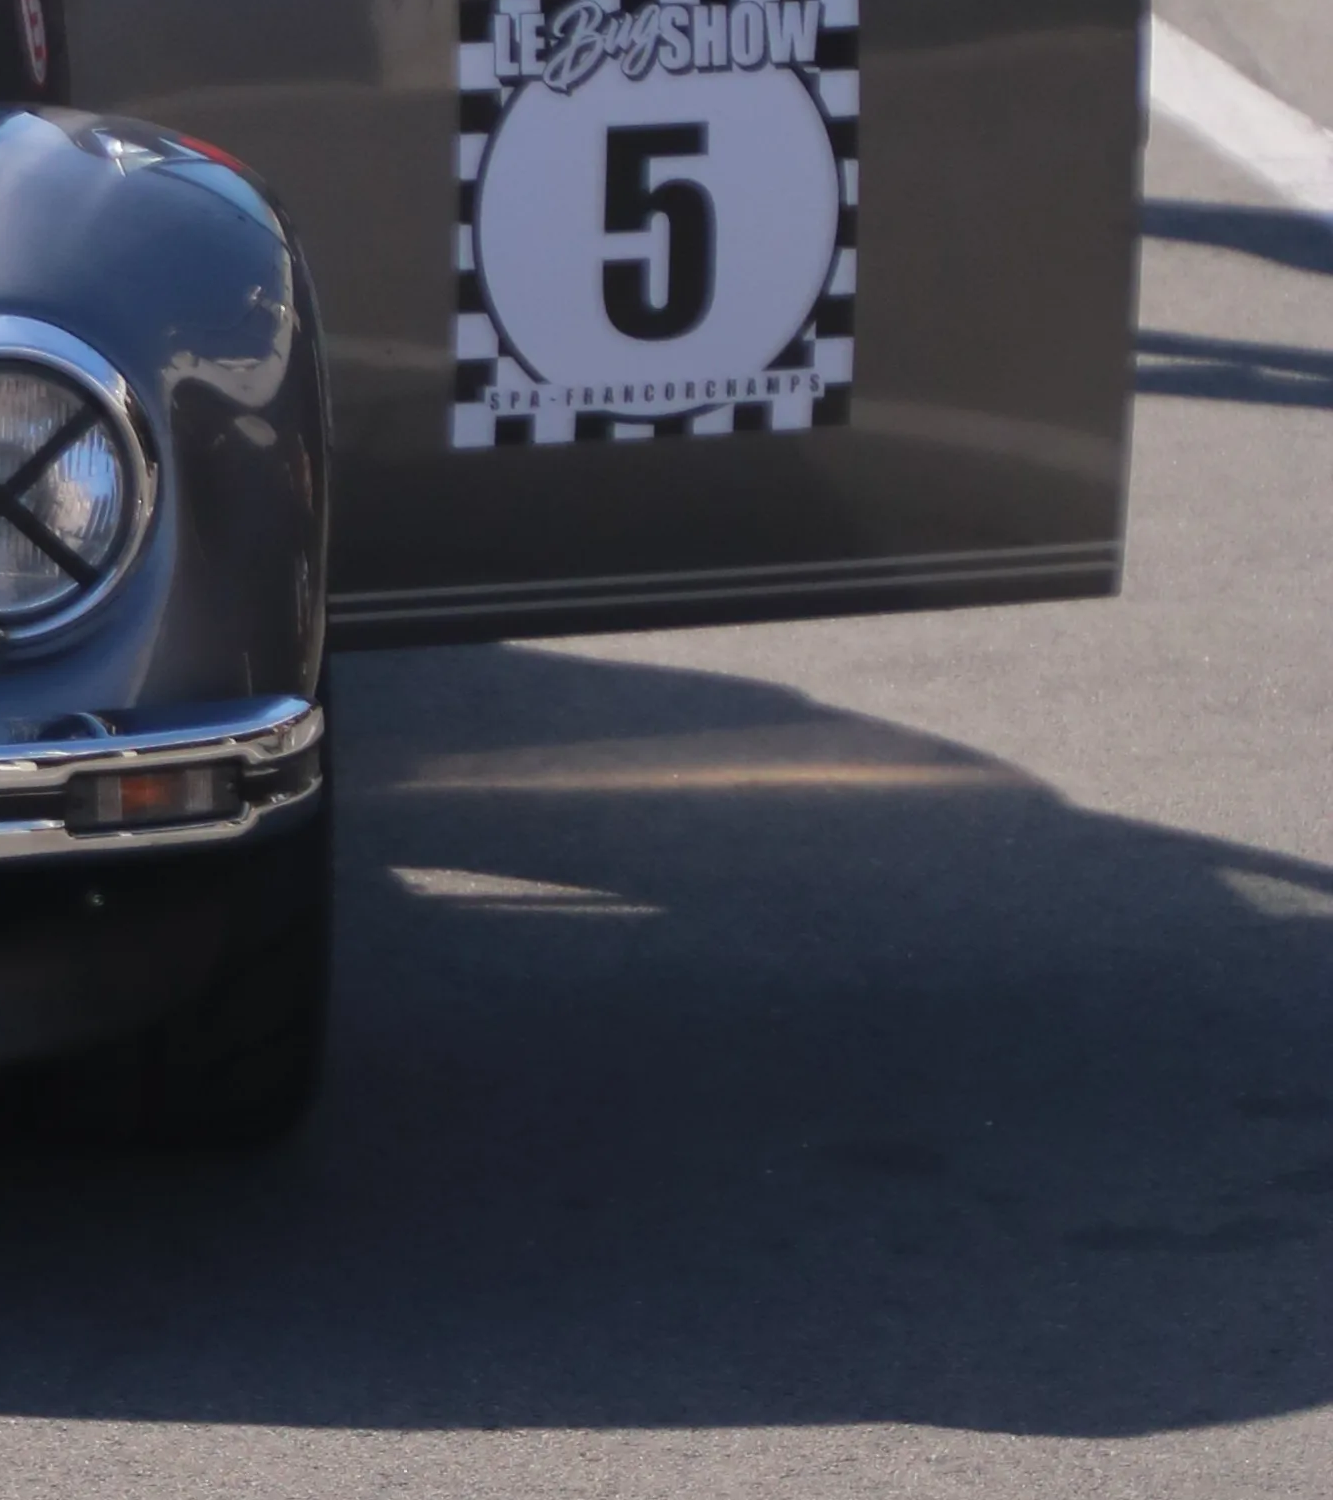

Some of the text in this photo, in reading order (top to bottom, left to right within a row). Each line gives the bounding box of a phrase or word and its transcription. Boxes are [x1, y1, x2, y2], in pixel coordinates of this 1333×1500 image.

[494, 0, 820, 95] LE Bug SHOW
[602, 121, 717, 342] 5
[489, 372, 821, 411] SPA-FRANCORCHAMPS
